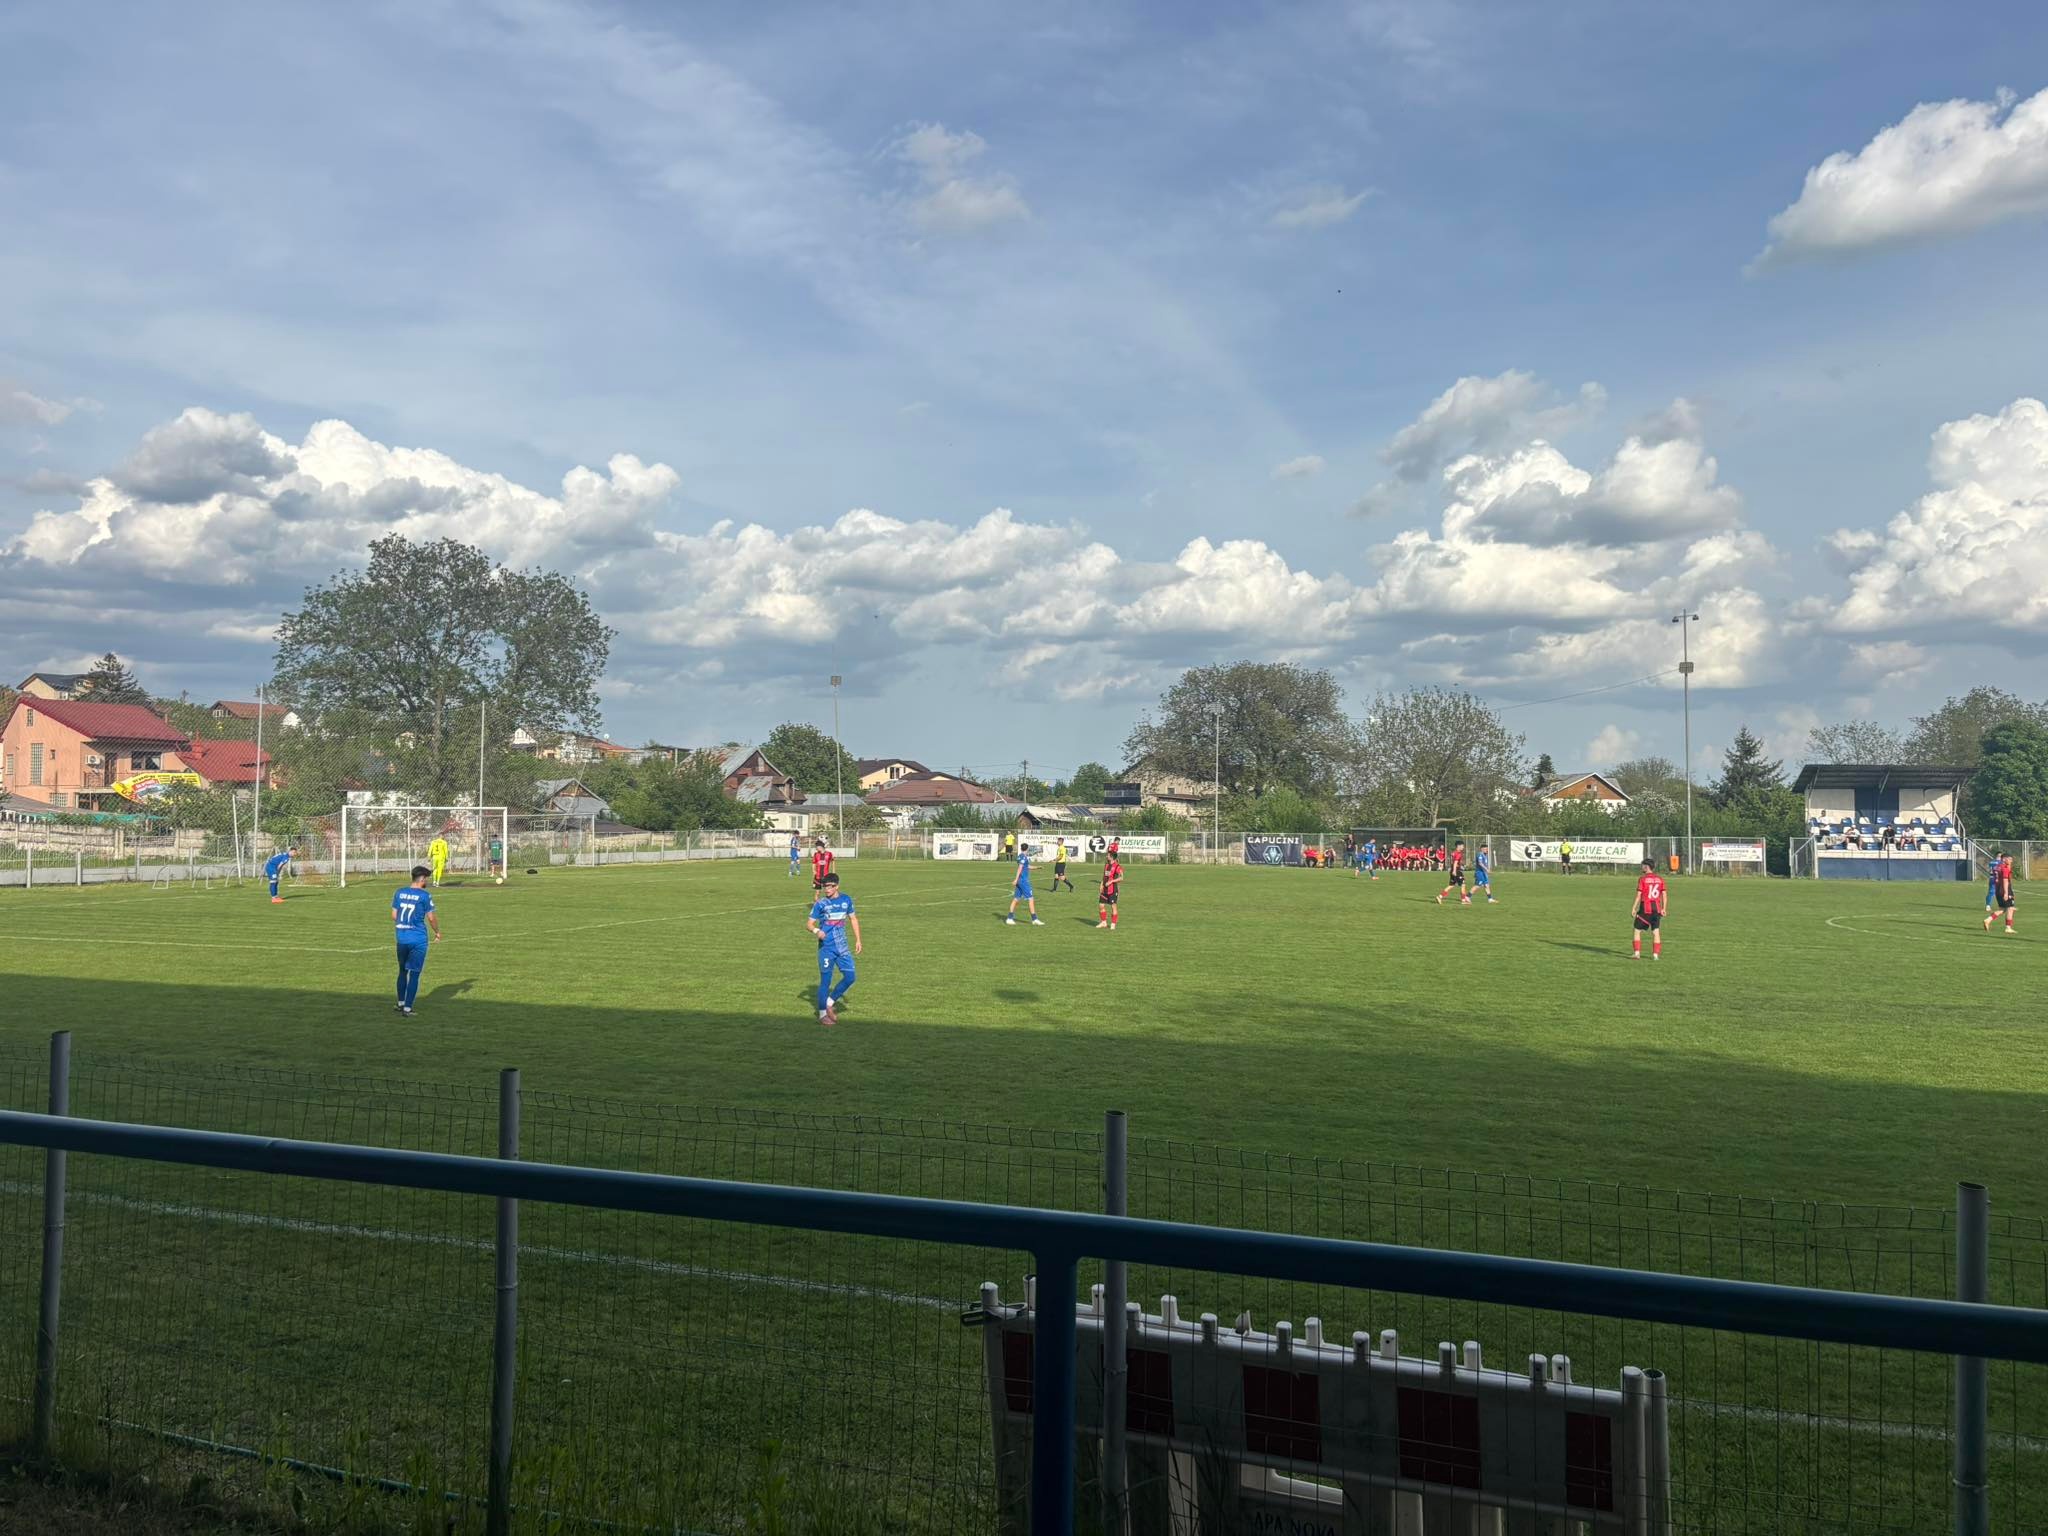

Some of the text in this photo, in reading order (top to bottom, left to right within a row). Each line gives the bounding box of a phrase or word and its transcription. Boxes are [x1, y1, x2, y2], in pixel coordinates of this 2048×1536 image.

[1147, 838, 1162, 847] CAR
[1247, 836, 1300, 845] CAPUCINI
[1545, 844, 1627, 856] EXUSIVE CAR
[1647, 883, 1660, 899] 16
[399, 902, 416, 923] 77
[823, 958, 830, 968] 3
